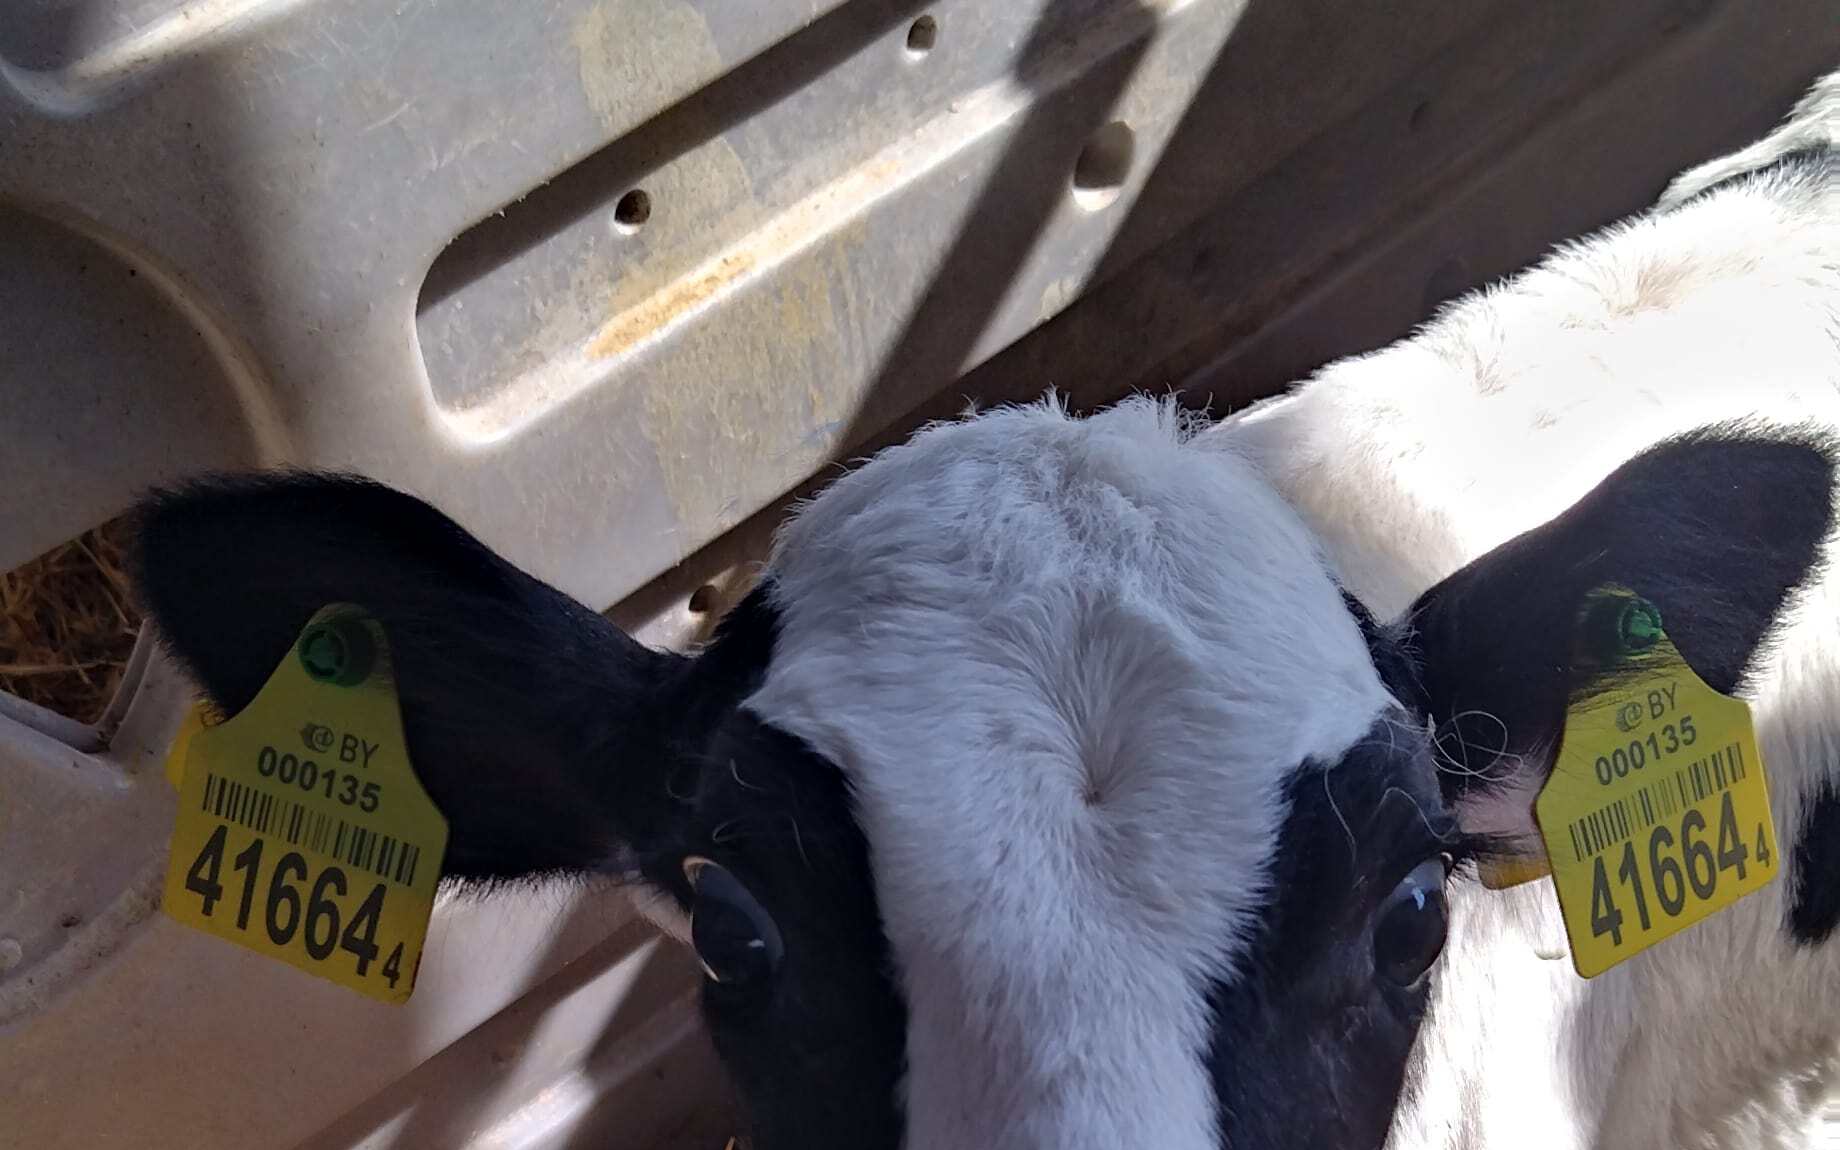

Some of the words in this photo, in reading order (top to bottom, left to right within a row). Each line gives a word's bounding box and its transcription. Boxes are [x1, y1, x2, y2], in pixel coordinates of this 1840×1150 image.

[257, 746, 380, 813] 000135
[1595, 715, 1697, 786] 000135
[185, 824, 387, 977] 41664
[382, 941, 405, 989] 4
[1591, 790, 1748, 946] 41664
[1755, 822, 1771, 868] 4
